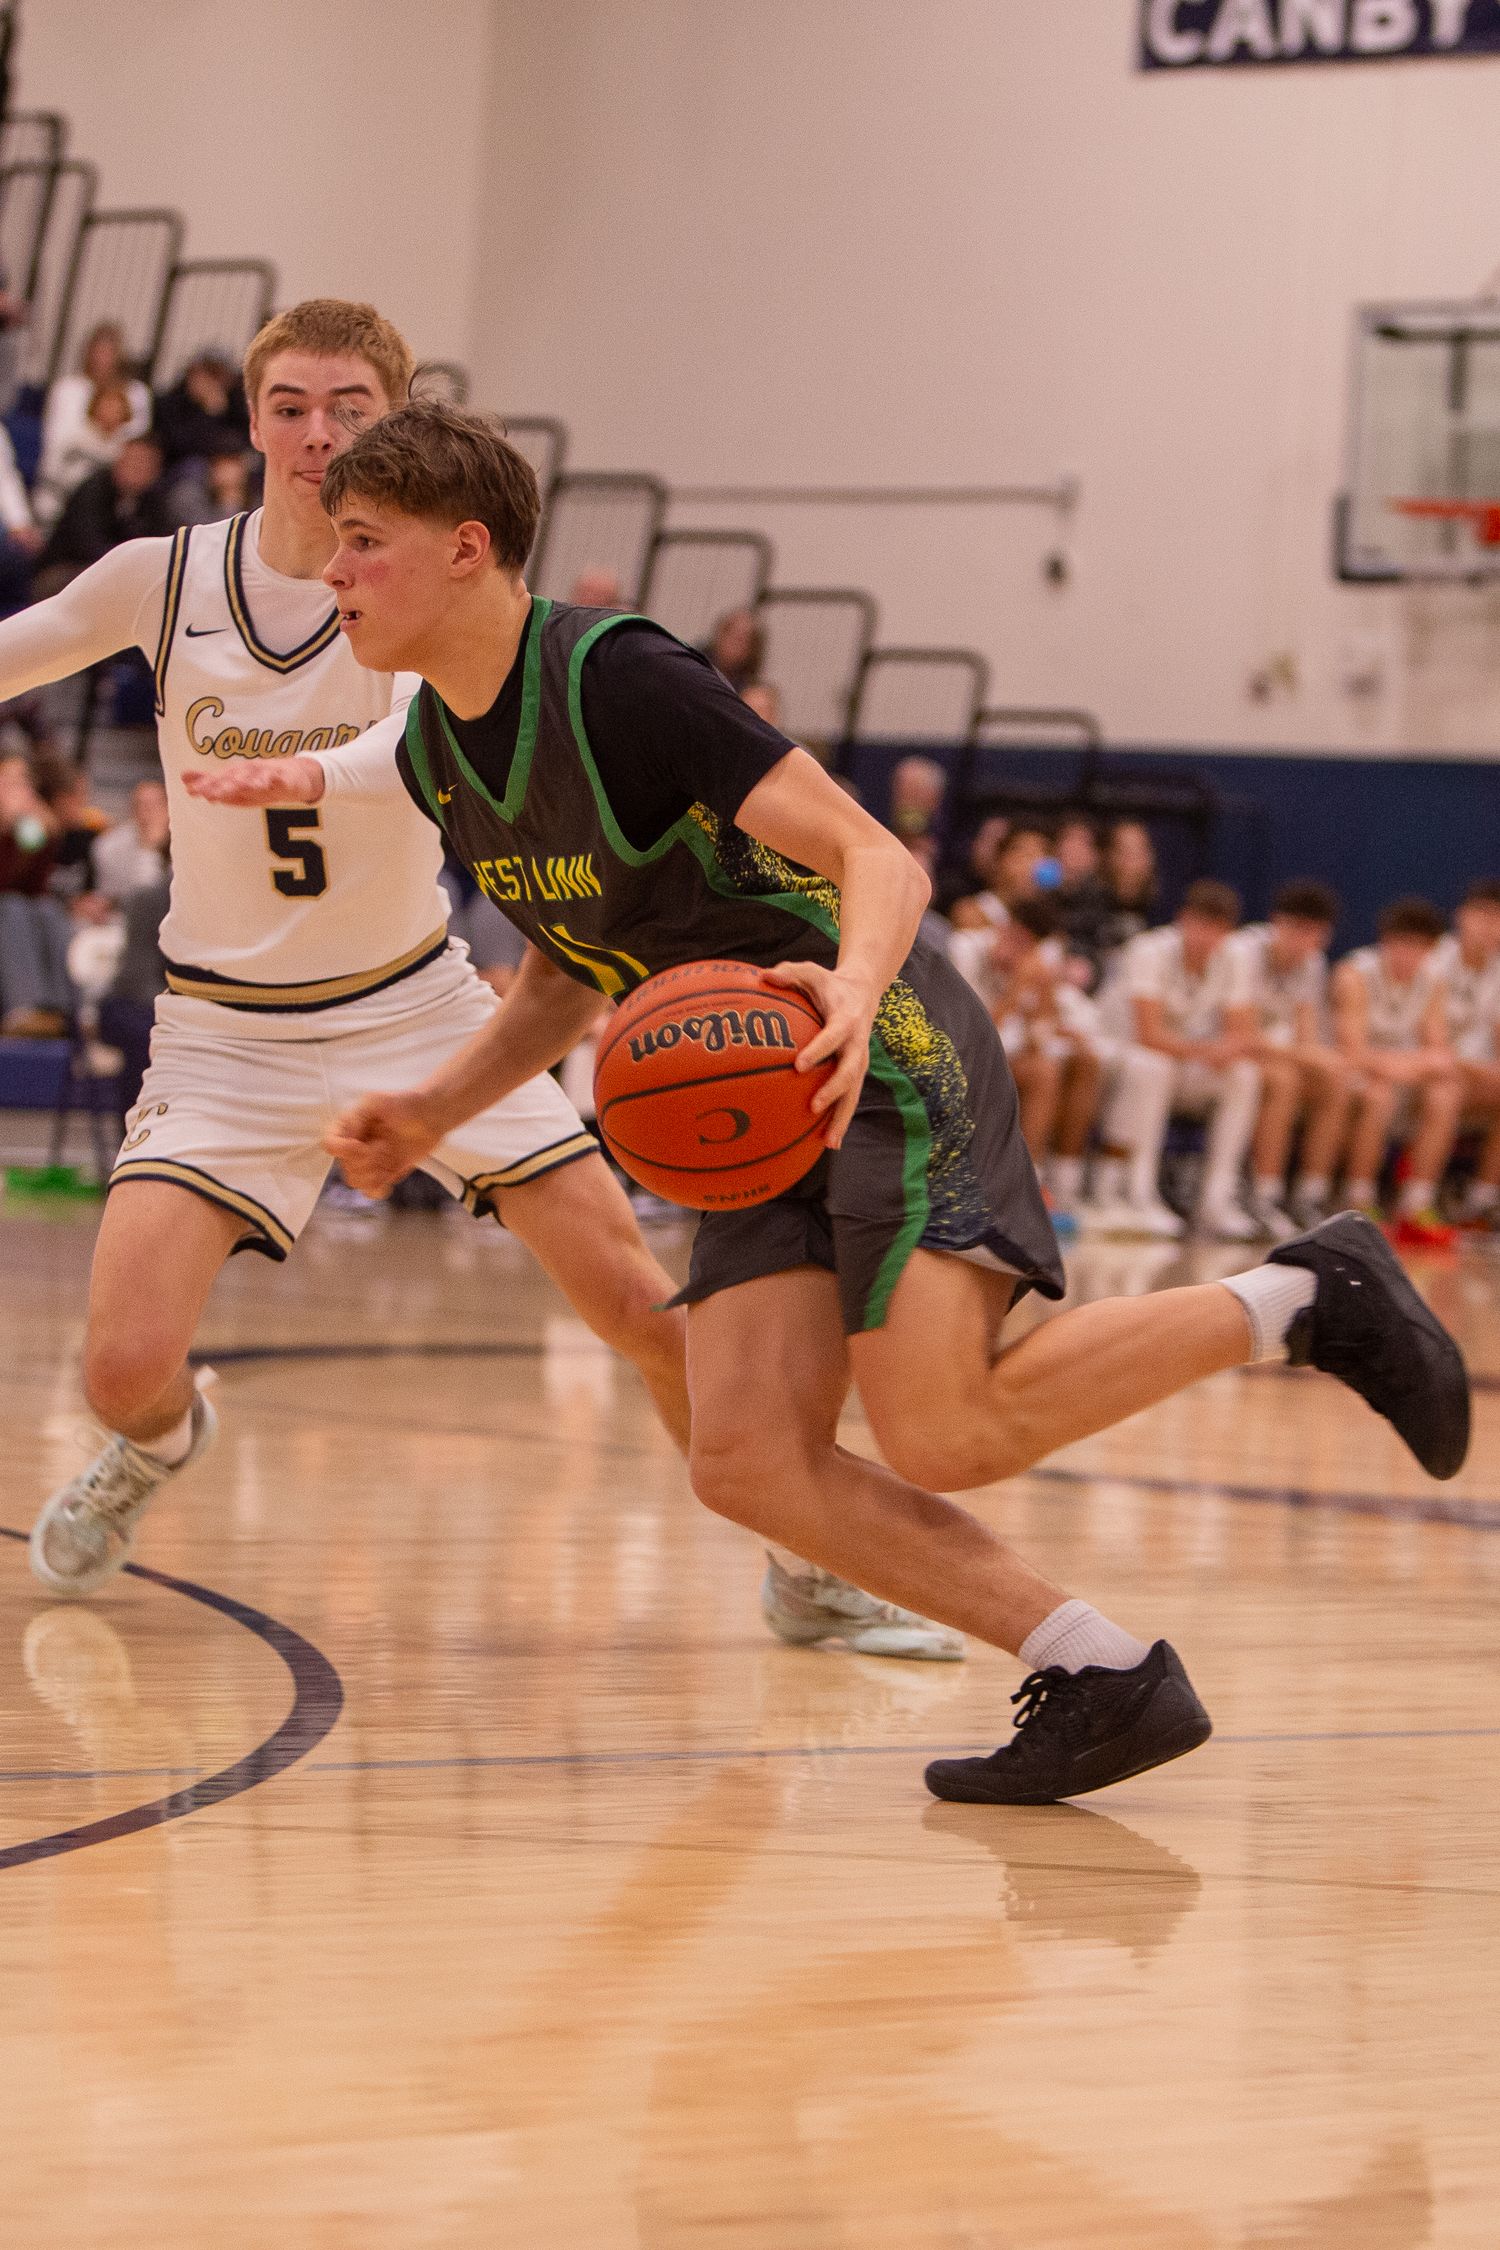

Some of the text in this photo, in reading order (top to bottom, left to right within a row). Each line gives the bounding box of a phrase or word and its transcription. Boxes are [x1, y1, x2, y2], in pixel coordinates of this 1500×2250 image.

[185, 696, 379, 759] Cougar
[263, 806, 330, 899] 5
[532, 852, 603, 901] LINN
[627, 1008, 796, 1064] Wilson
